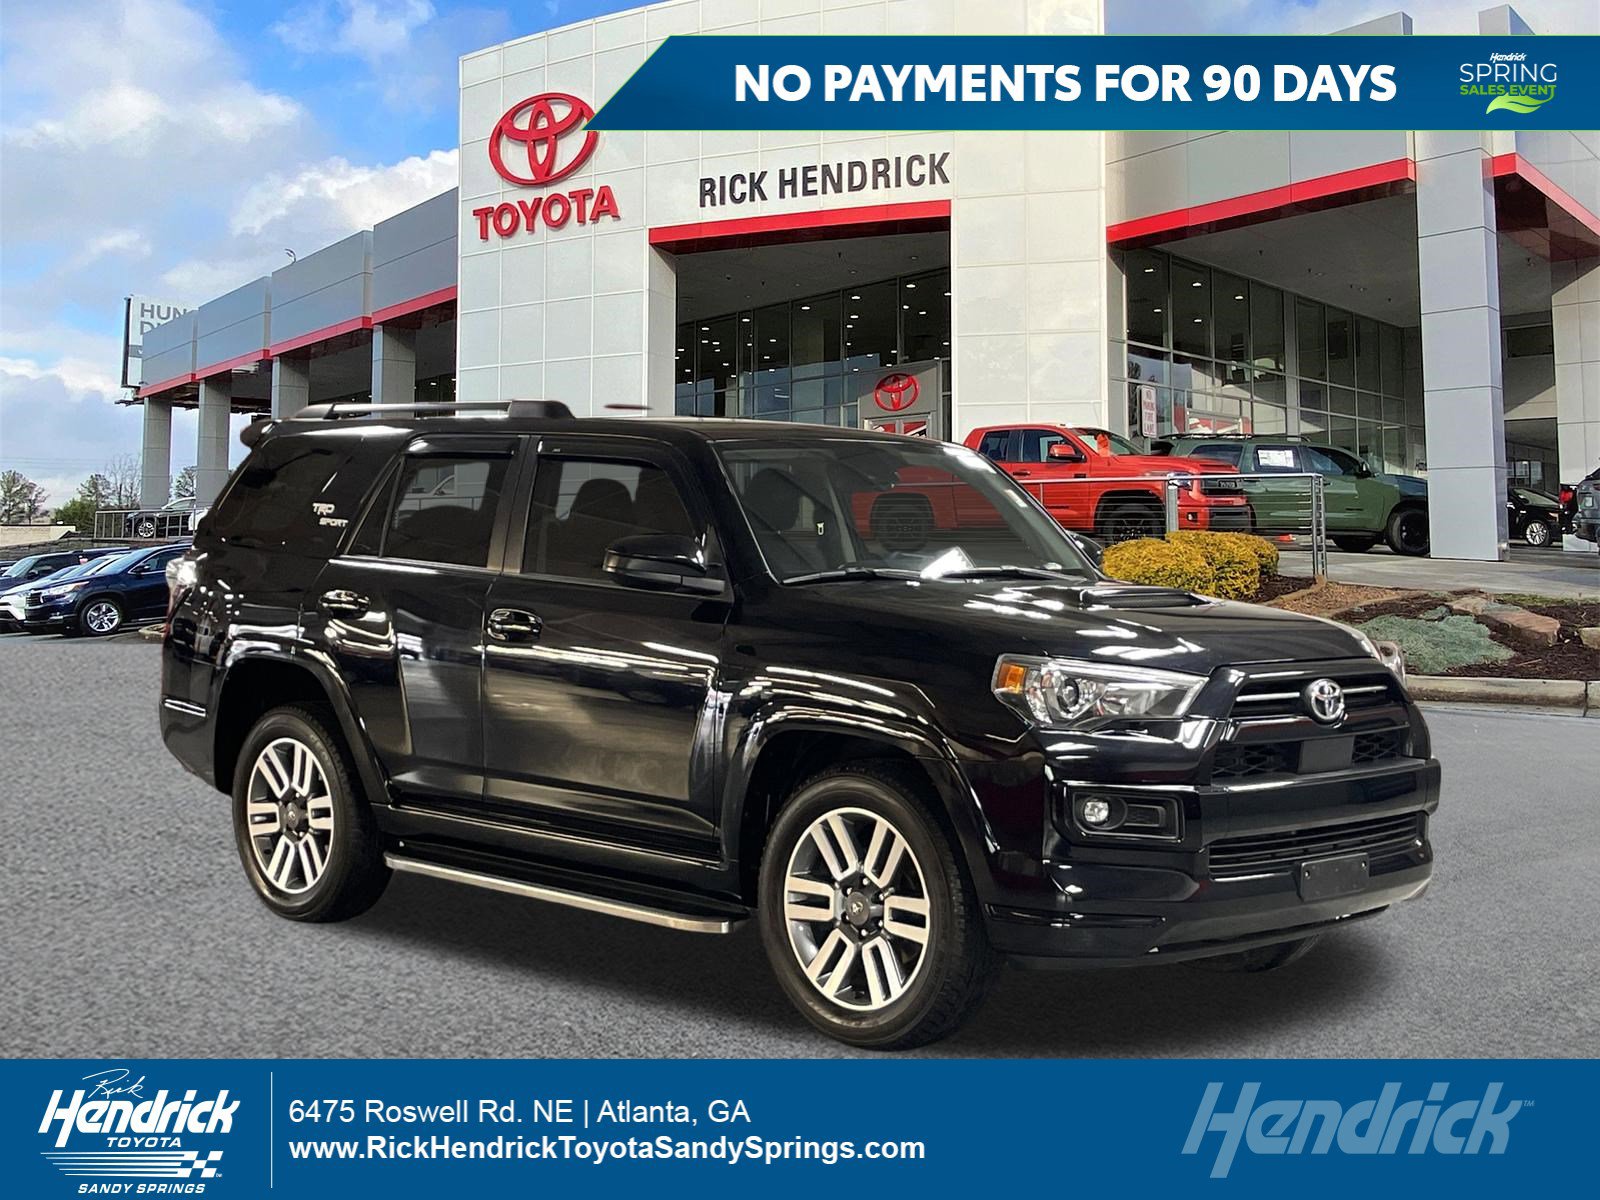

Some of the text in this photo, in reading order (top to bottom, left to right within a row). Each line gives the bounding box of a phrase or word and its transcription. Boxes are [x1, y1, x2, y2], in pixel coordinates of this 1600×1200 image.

[699, 151, 951, 208] RICK HENDRICK
[472, 185, 620, 241] TOYOTA
